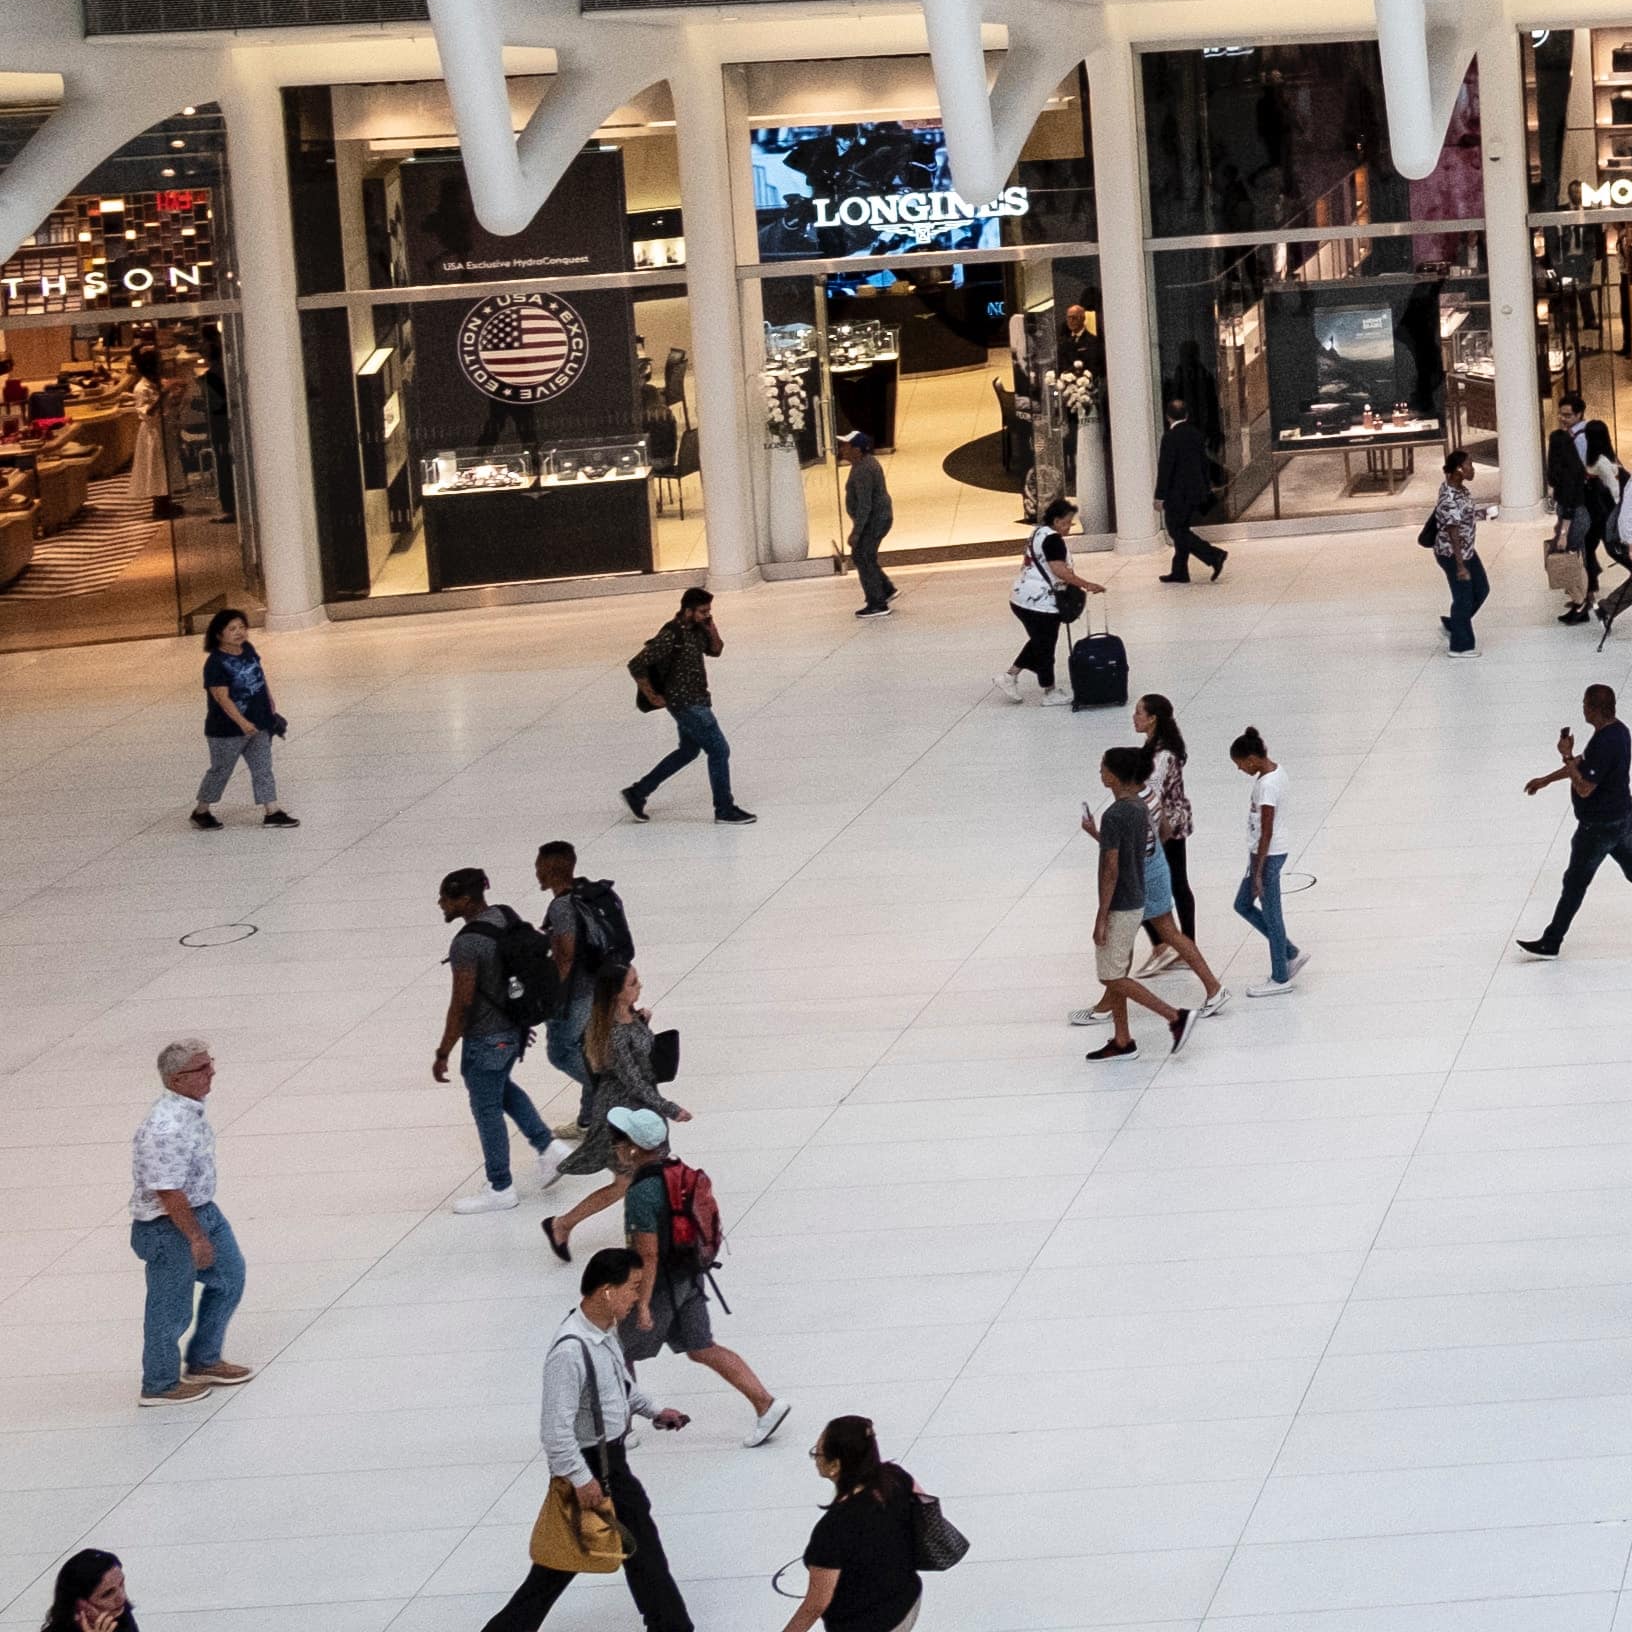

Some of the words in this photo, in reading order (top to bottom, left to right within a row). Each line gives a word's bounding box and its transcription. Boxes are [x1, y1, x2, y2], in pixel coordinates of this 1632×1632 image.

[443, 262, 465, 271] USA
[466, 259, 512, 270] Exclusive
[513, 256, 590, 268] HydroConquest
[496, 294, 543, 306] USA
[463, 317, 499, 392] EDITION
[519, 310, 584, 399] EXCLUSIVE
